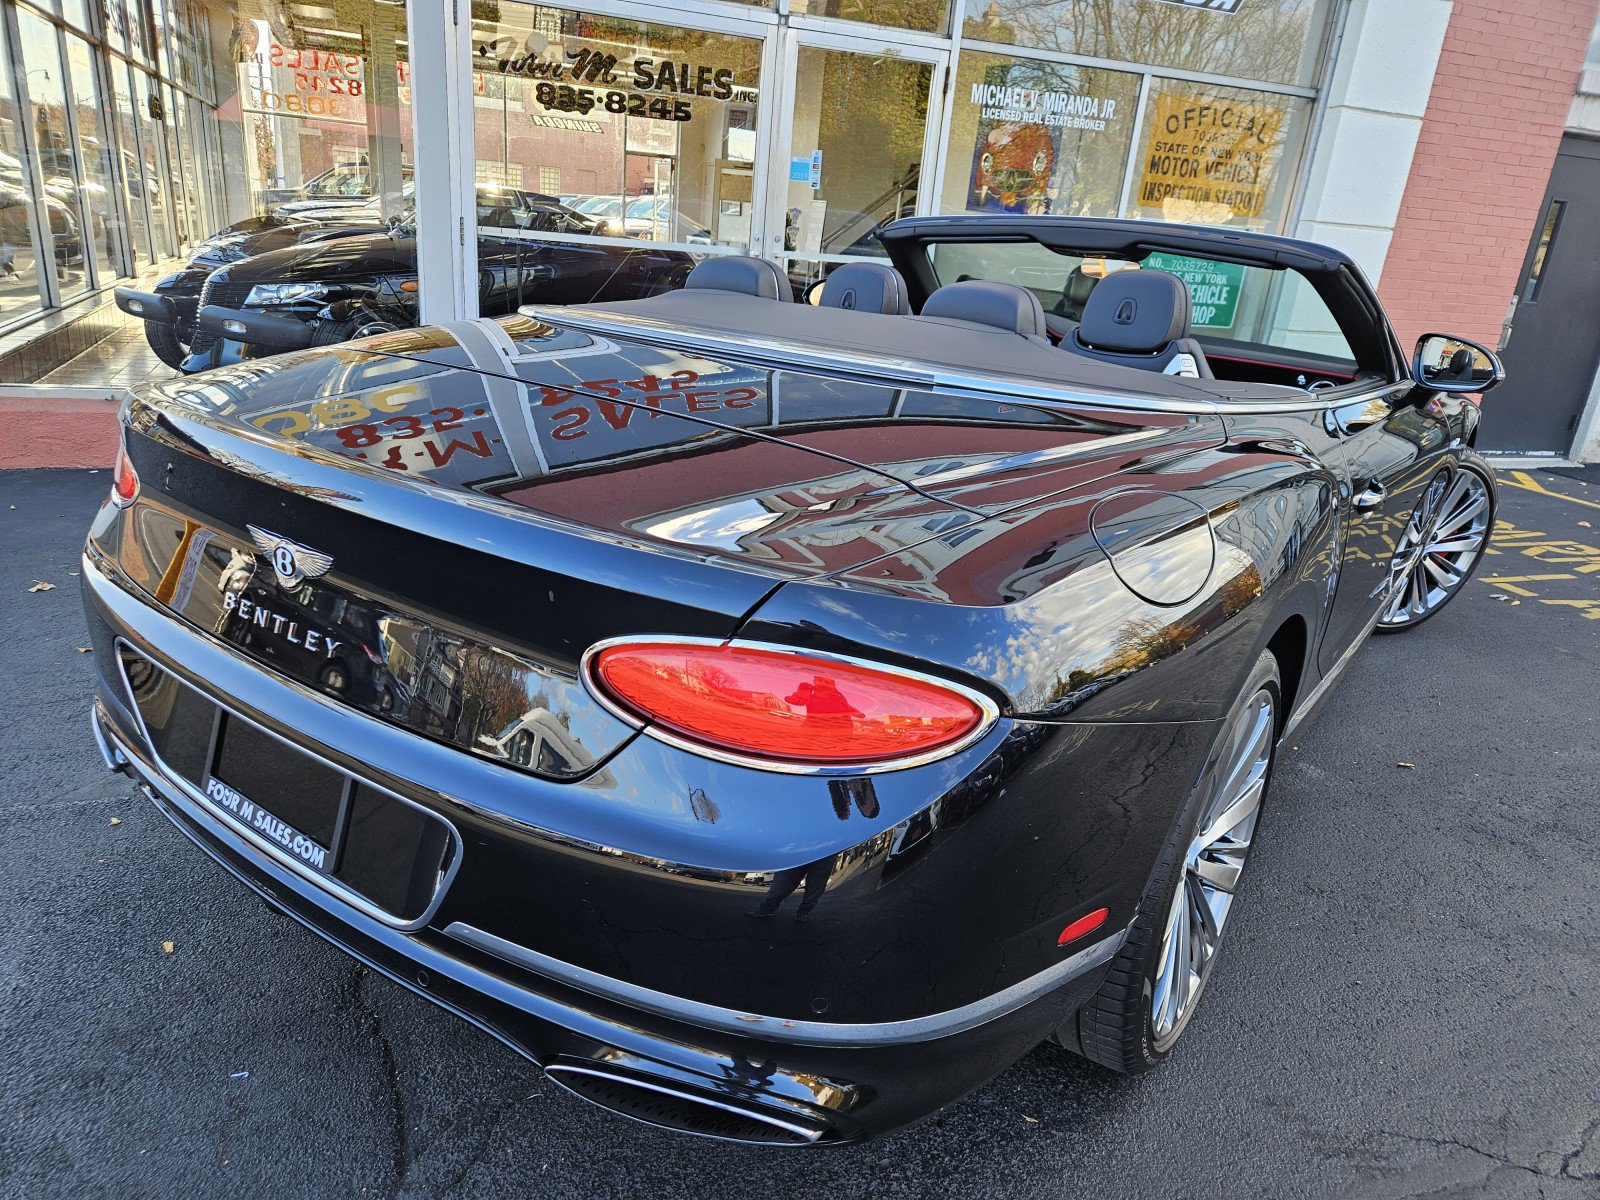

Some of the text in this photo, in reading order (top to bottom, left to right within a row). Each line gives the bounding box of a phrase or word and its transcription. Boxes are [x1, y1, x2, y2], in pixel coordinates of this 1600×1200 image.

[633, 56, 735, 102] SALES
[970, 82, 1027, 109] MICHAEL
[1042, 91, 1099, 118] MIRANDA
[1100, 98, 1117, 120] JR.
[981, 107, 1106, 131] LICENSED REAL ESTATE BROKER
[1165, 105, 1267, 145] OFFICIAL
[1154, 140, 1189, 154] STATE
[1191, 145, 1207, 156] OF
[1210, 148, 1235, 160] NEW
[1148, 154, 1200, 178] MOTOR
[1148, 257, 1215, 272] NO. 7038729
[1184, 271, 1204, 283] NEW
[1205, 273, 1228, 285] YORK
[1189, 284, 1230, 305] EHICLE
[1191, 305, 1216, 325] HOP
[223, 591, 343, 658] BENTLEY
[207, 778, 325, 869] FOUR M SALES.COM
